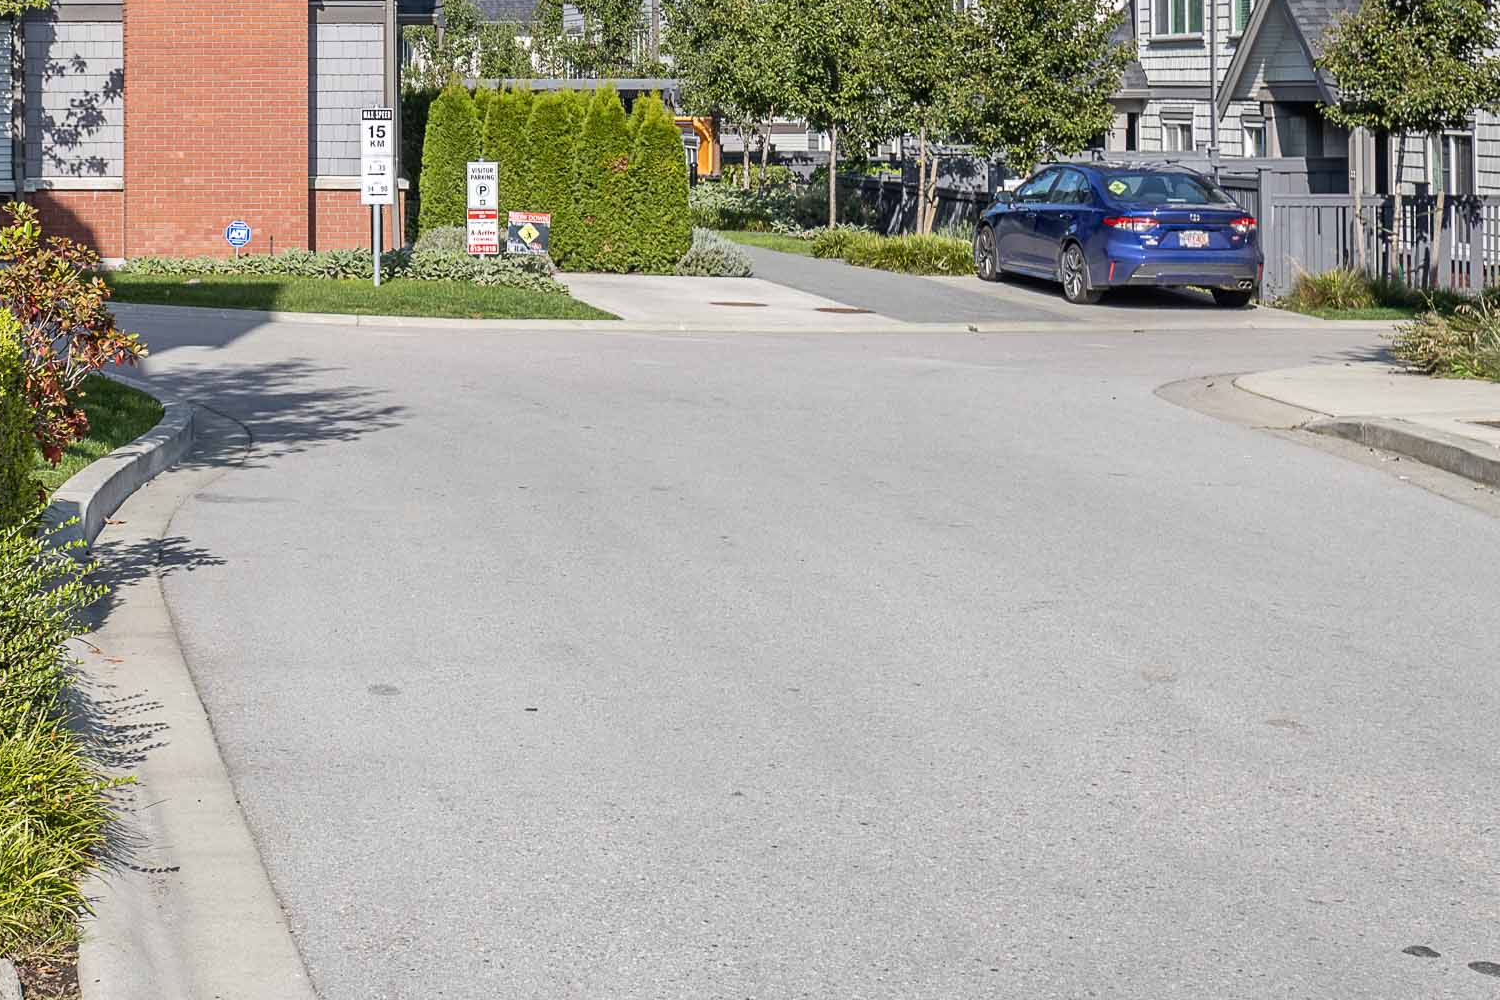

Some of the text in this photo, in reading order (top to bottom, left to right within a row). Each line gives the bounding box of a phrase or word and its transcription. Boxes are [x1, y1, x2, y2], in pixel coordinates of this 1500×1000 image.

[363, 110, 391, 119] MAX SPEED
[368, 125, 386, 138] 15
[370, 140, 385, 148] KM
[479, 185, 487, 195] P
